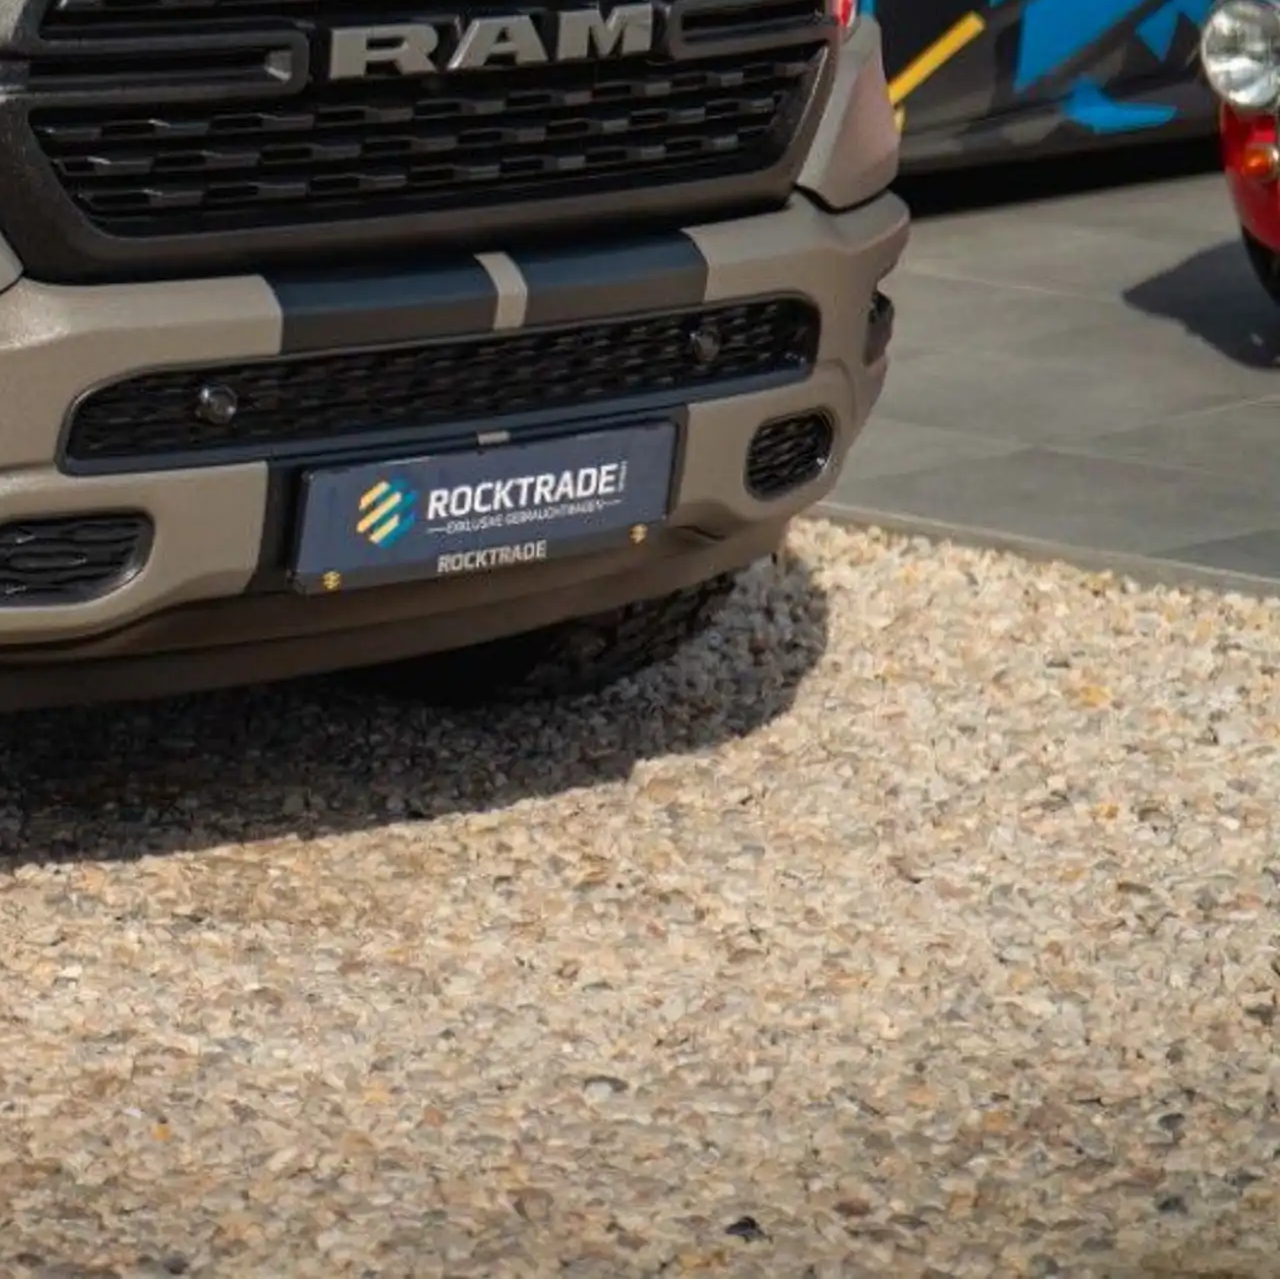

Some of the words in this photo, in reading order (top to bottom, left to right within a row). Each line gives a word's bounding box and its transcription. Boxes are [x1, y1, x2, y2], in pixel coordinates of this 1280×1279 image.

[328, 1, 654, 81] RAM
[426, 463, 619, 521] ROCKTRADE
[436, 539, 548, 573] ROCKTRADE
